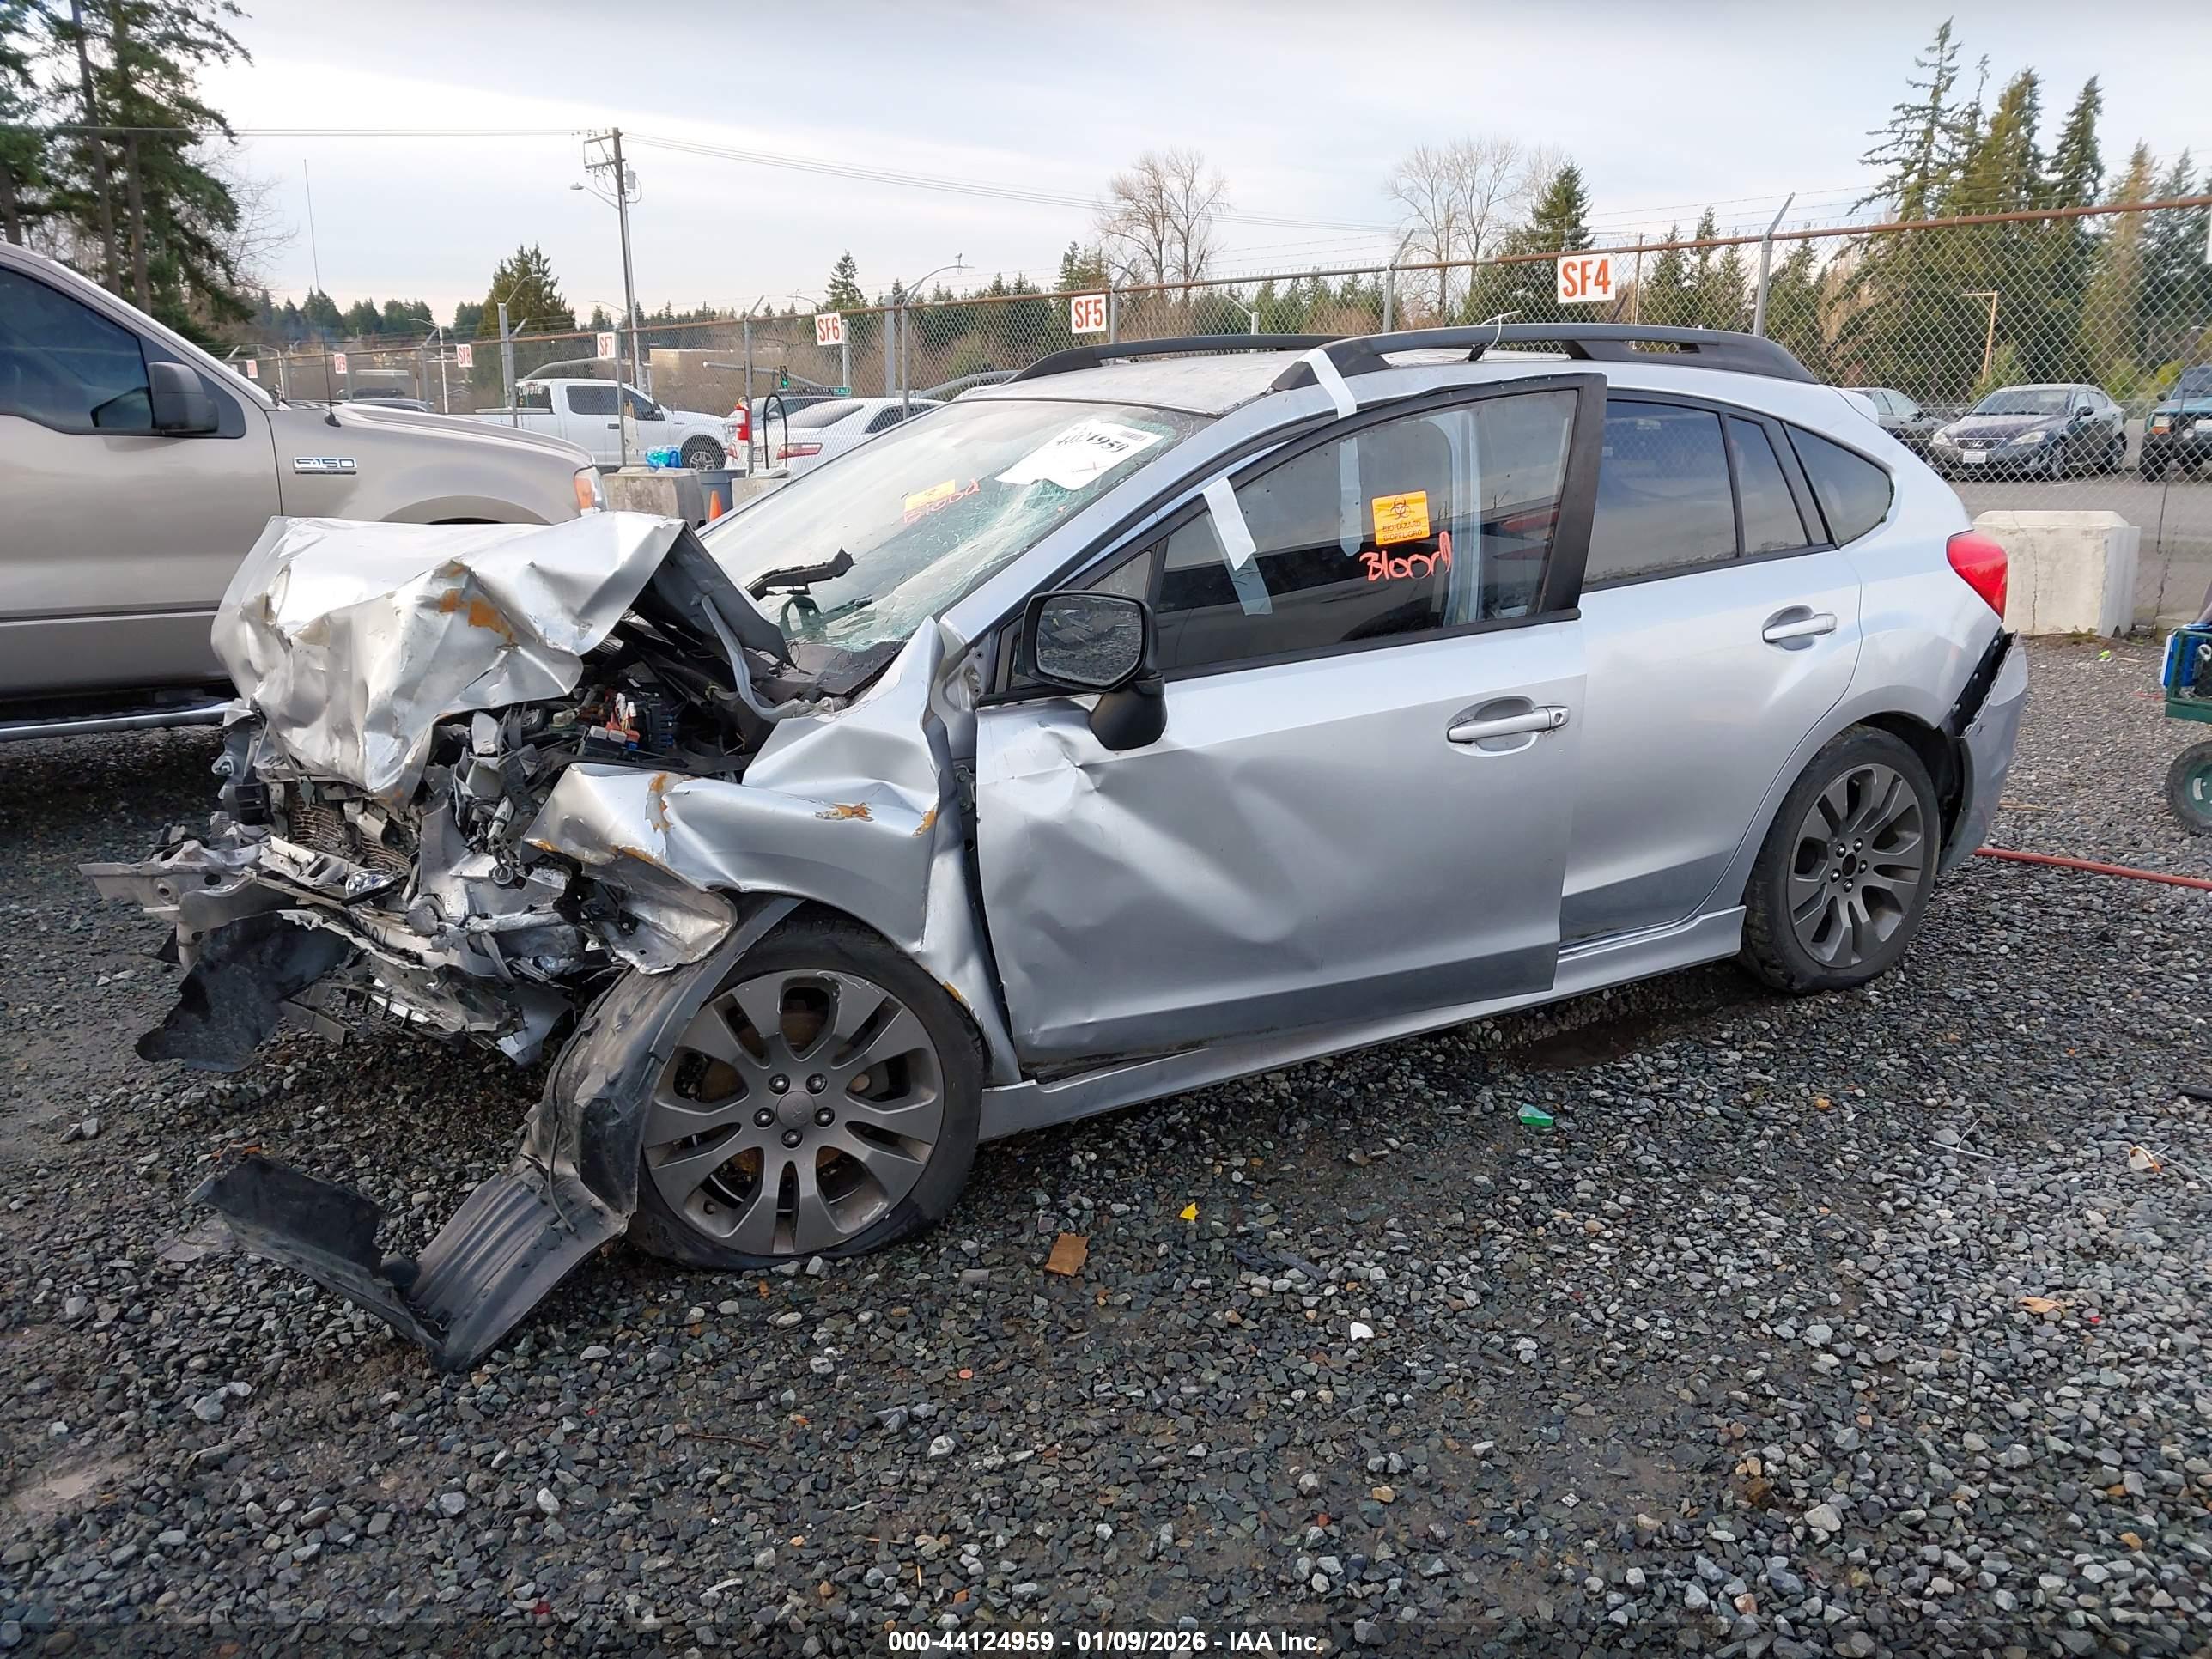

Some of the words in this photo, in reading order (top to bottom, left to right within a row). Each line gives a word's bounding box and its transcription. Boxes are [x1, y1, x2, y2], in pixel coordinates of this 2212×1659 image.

[1562, 259, 1612, 298] SF4
[1074, 299, 1103, 329] SF5
[817, 316, 840, 342] SF6
[599, 336, 612, 356] SF7
[294, 457, 356, 469] F-150
[1382, 520, 1423, 533] BIOHAZARD
[1383, 529, 1424, 543] BIOPELIGRO
